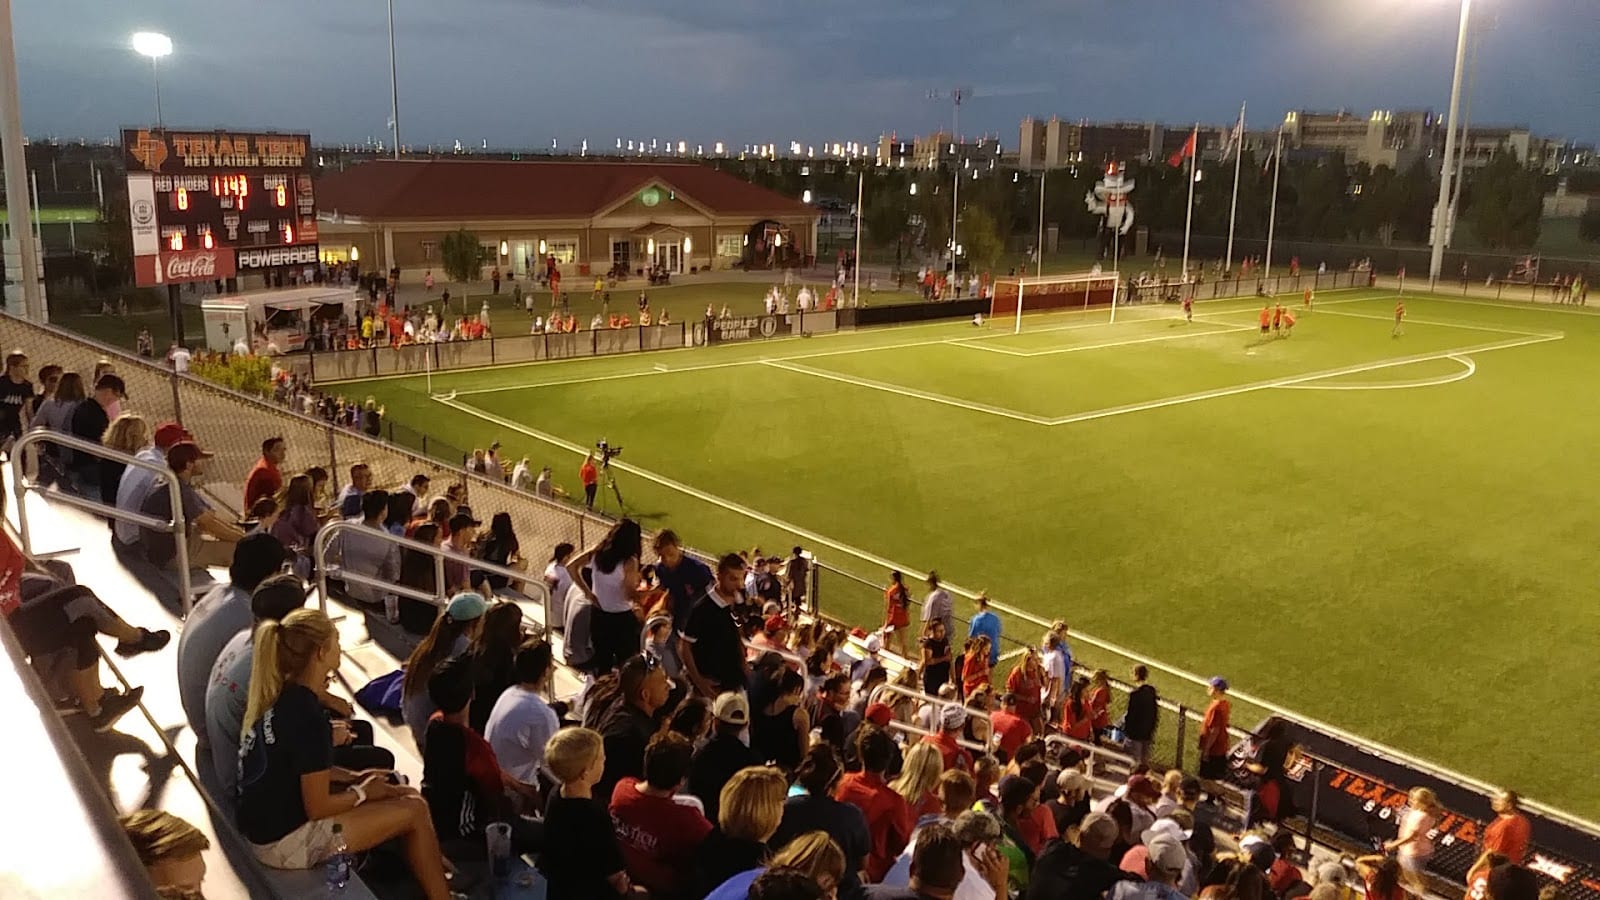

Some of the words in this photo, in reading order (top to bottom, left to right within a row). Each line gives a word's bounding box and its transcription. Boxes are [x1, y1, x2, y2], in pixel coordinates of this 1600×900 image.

[172, 134, 248, 156] TEXAS
[256, 136, 305, 157] TECH
[184, 154, 209, 168] RED
[214, 154, 259, 168] RAIDER
[262, 154, 302, 168] SOCCER
[155, 175, 172, 192] RED
[174, 175, 209, 192] RAIDERS
[238, 246, 317, 269] POWERADE
[713, 318, 758, 331] PEOPLES
[721, 329, 750, 340] BANK
[1329, 769, 1410, 808] TEXA
